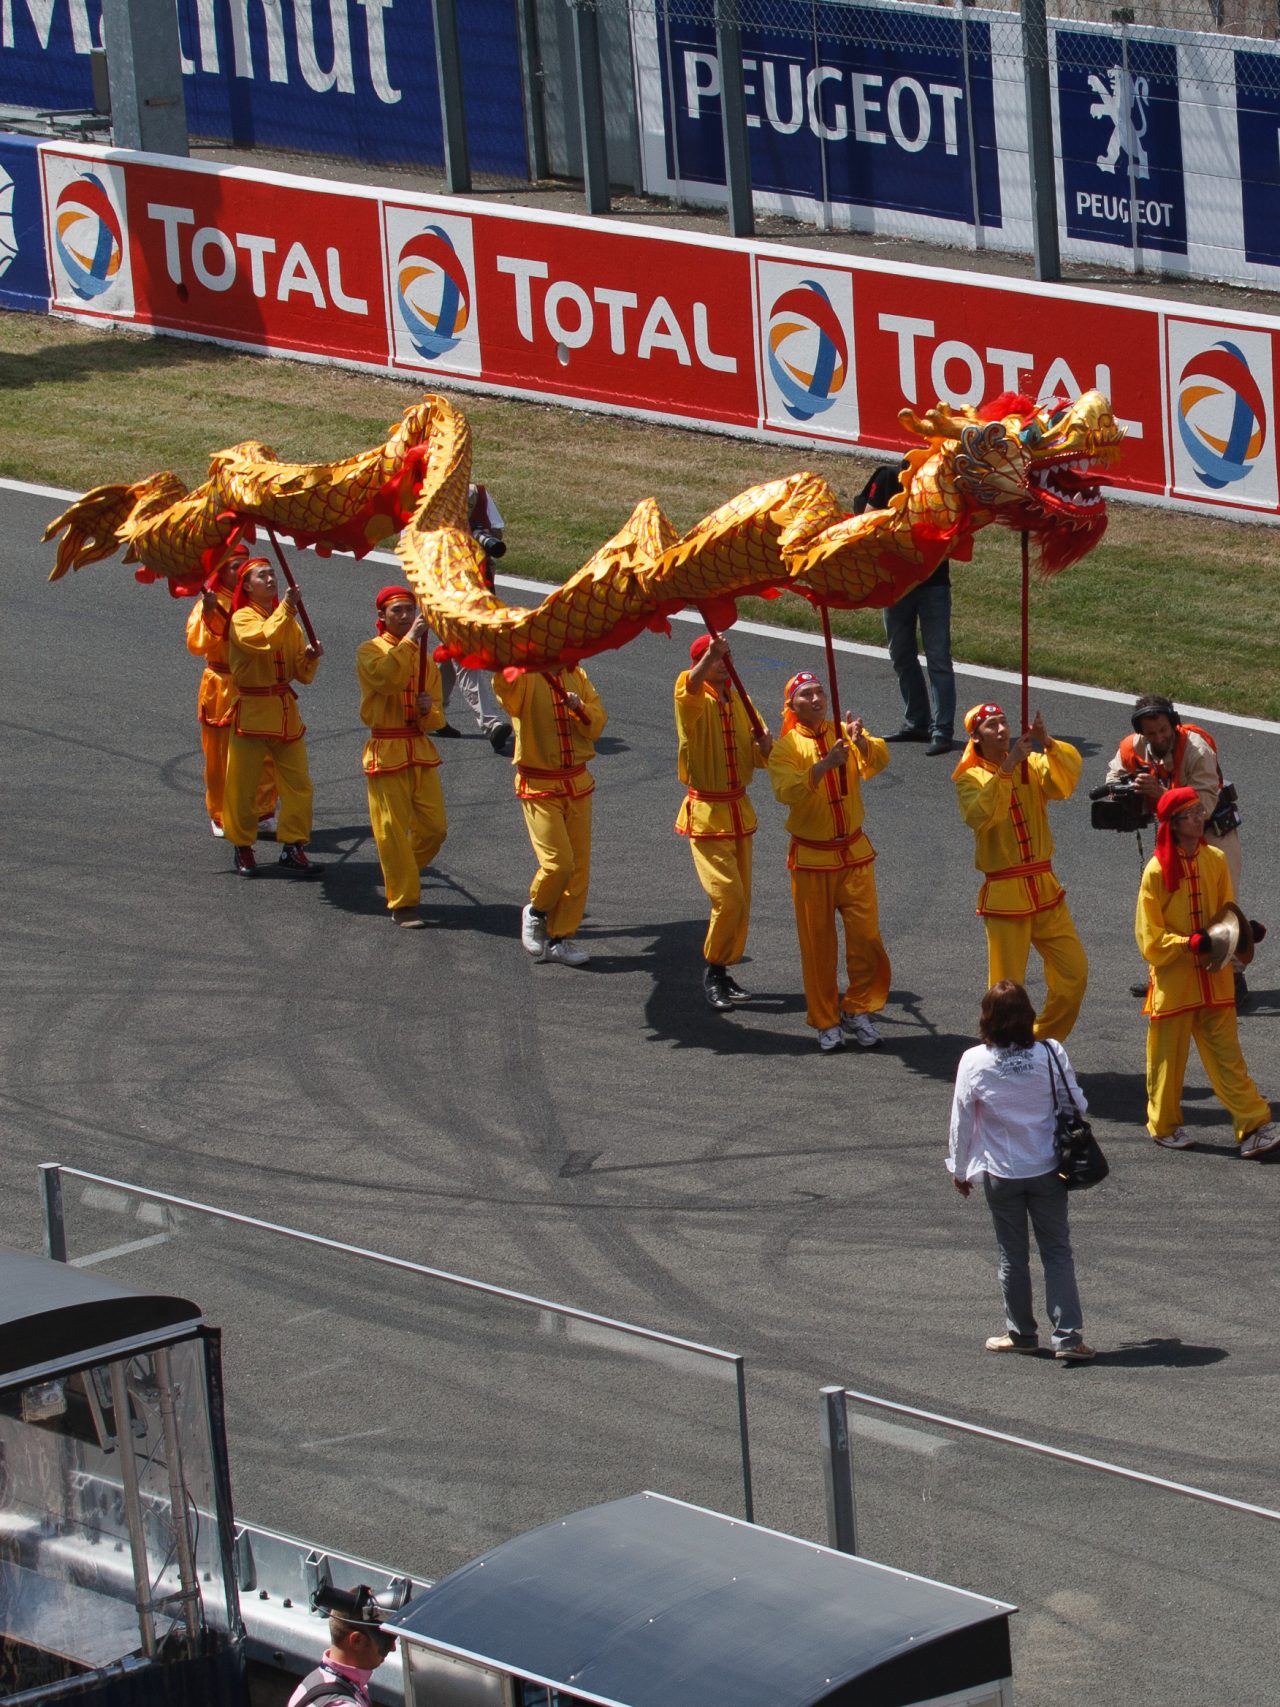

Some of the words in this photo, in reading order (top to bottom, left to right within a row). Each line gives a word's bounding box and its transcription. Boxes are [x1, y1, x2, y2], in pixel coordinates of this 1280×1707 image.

[1, 0, 402, 104] mut
[147, 202, 368, 315] TOTAL
[1076, 191, 1174, 228] PEUGEOT
[497, 255, 737, 374] TOTAL
[878, 312, 1143, 439] TOTAL
